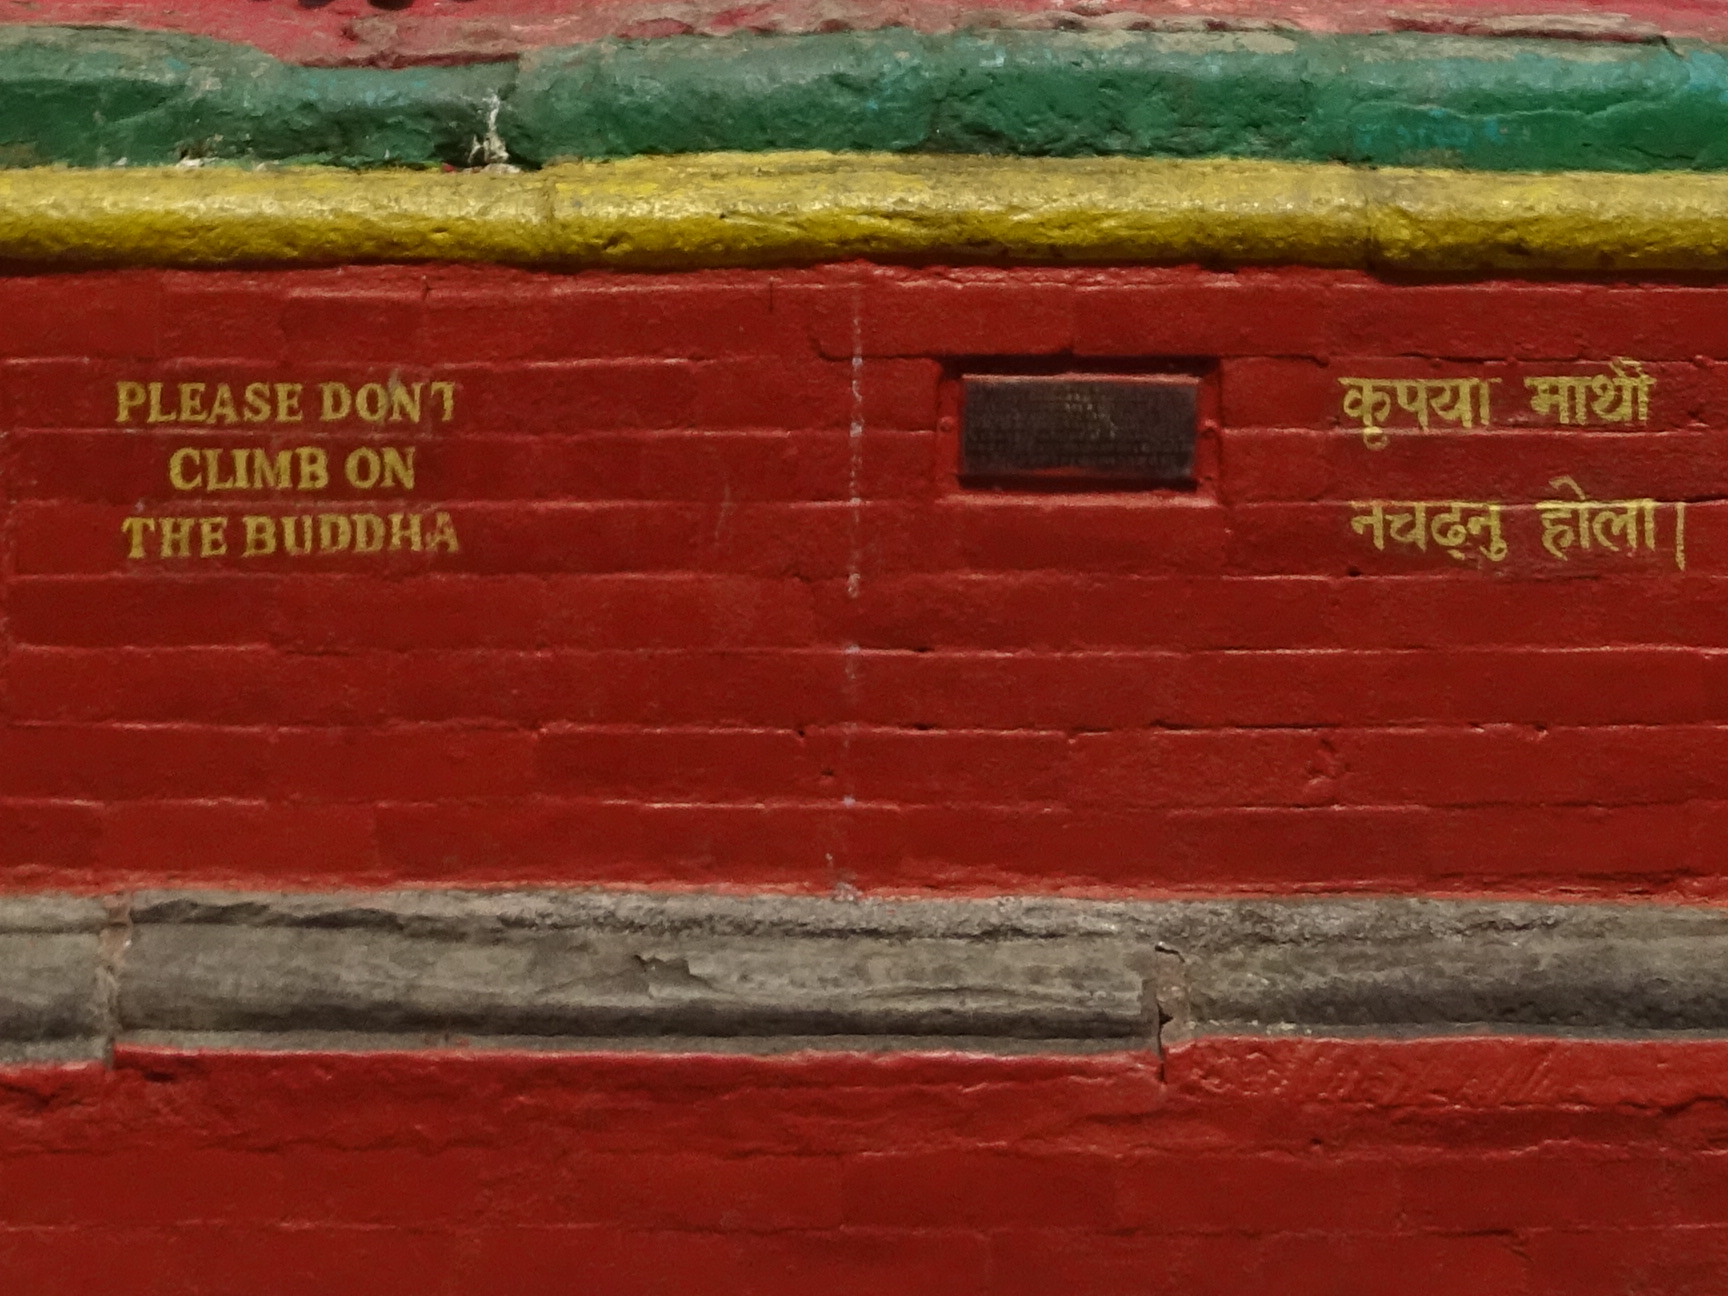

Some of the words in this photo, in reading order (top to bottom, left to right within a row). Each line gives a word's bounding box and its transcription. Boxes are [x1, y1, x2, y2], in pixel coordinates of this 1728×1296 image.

[115, 380, 303, 424] PLEASE
[1338, 376, 1503, 451] कृपया
[169, 446, 329, 492] CLIMB
[345, 446, 416, 491] ON
[122, 515, 228, 560] THE
[241, 511, 461, 559] BUDDHA
